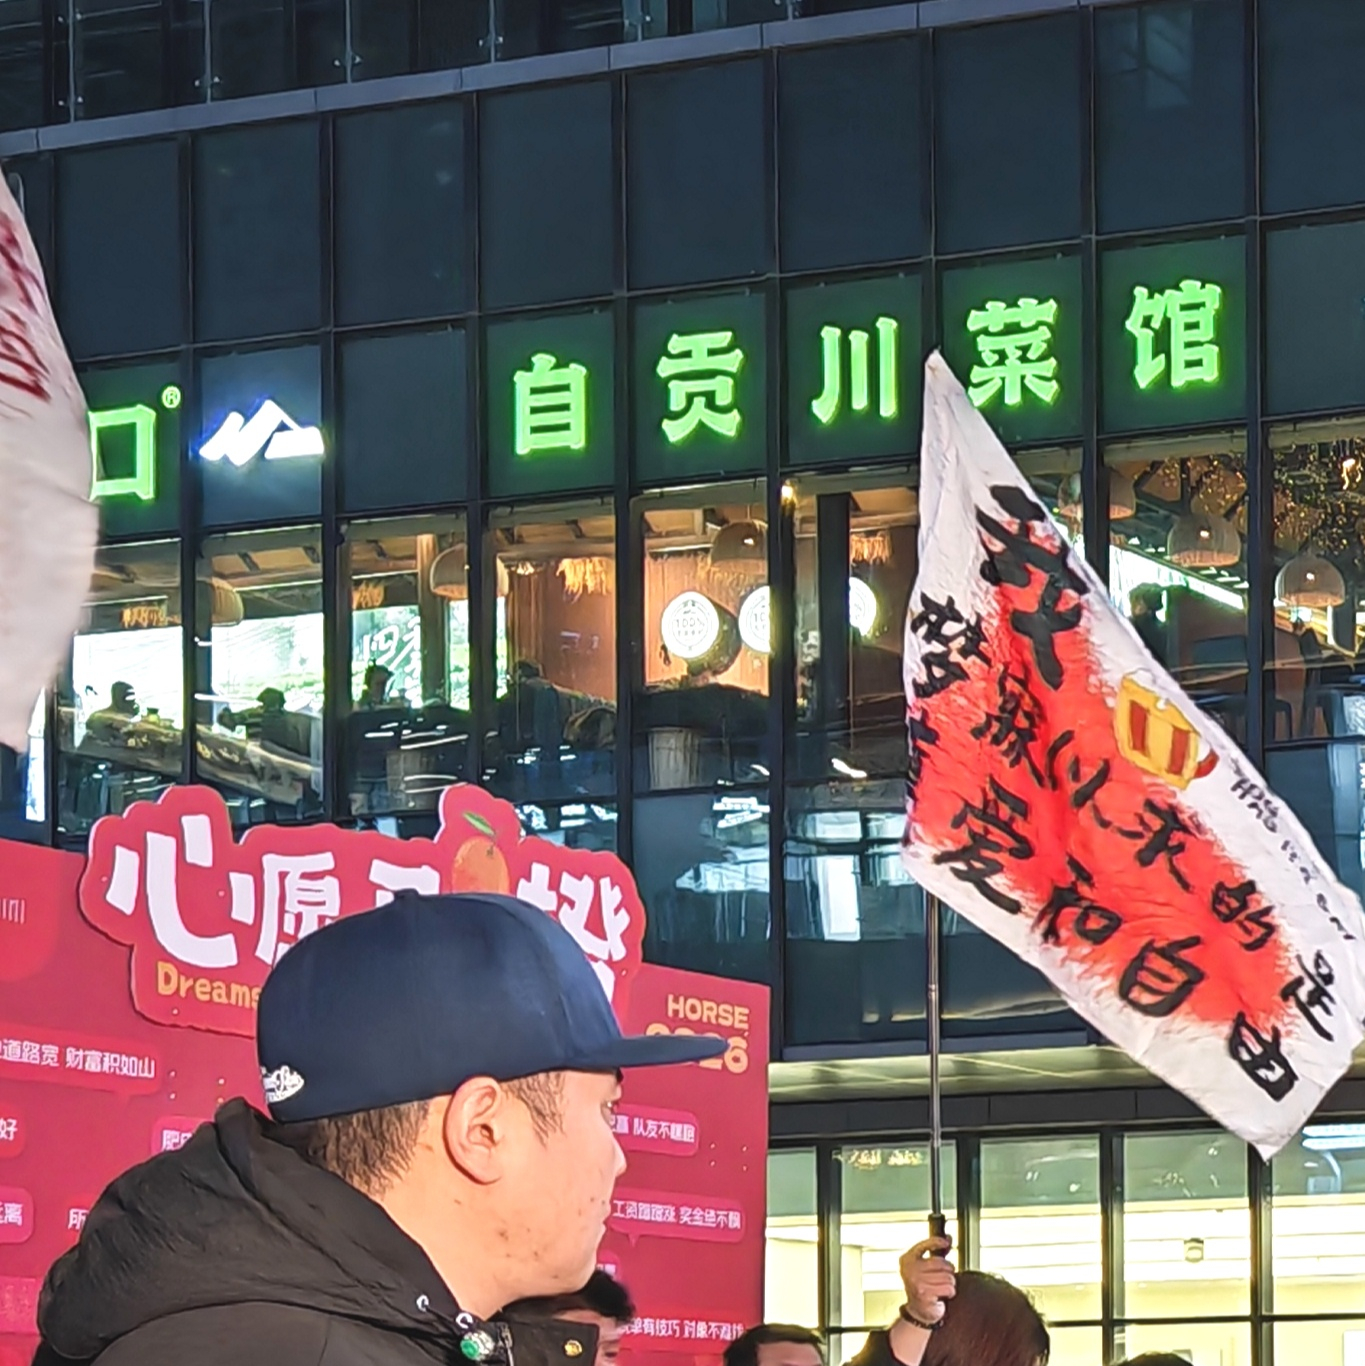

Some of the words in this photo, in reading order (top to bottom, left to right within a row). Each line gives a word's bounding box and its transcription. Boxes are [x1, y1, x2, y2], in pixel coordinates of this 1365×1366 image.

[513, 278, 1222, 455] 自贡川菜馆
[667, 993, 750, 1029] HORSE
[0, 1039, 59, 1067] 道路宽
[65, 1047, 155, 1079] 财富积如山
